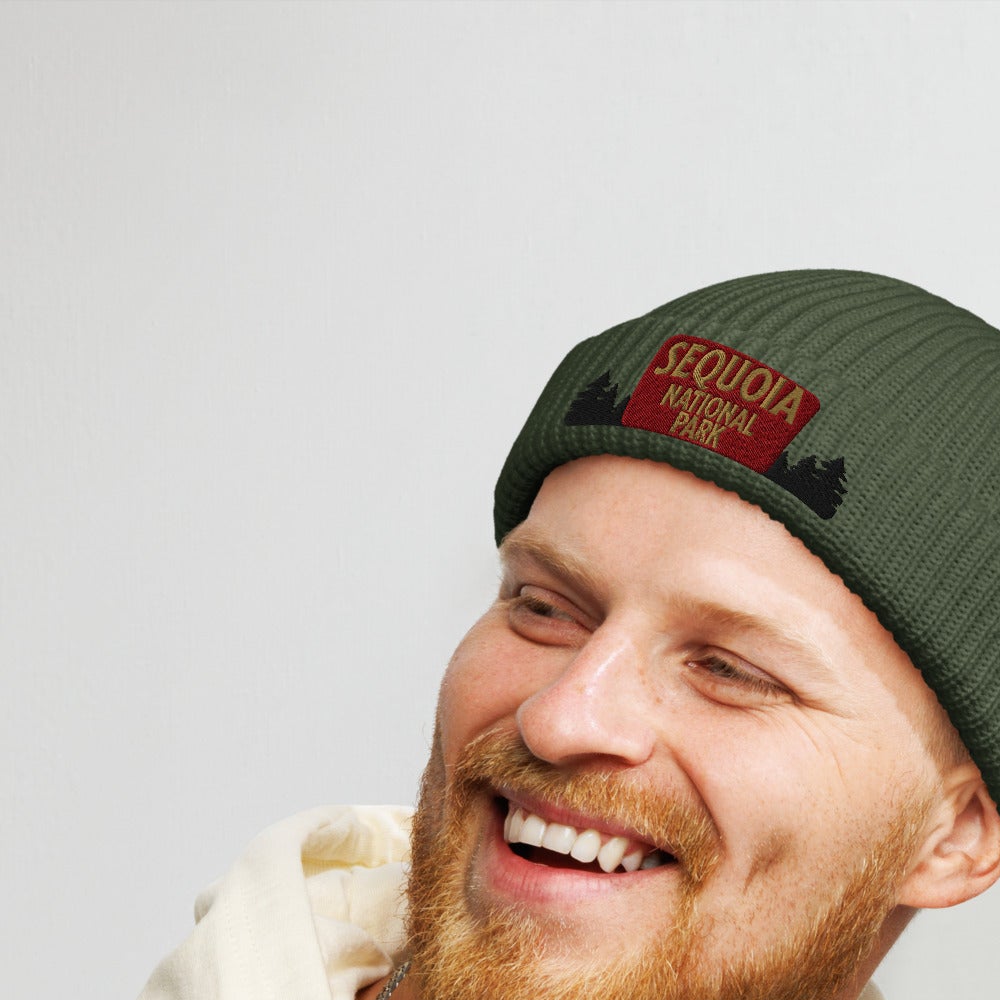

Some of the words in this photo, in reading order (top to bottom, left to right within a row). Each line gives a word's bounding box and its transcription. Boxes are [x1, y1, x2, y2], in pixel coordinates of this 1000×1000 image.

[654, 341, 805, 426] SEQUOIA
[660, 383, 759, 437] NATIONAL
[668, 411, 727, 449] PARK
